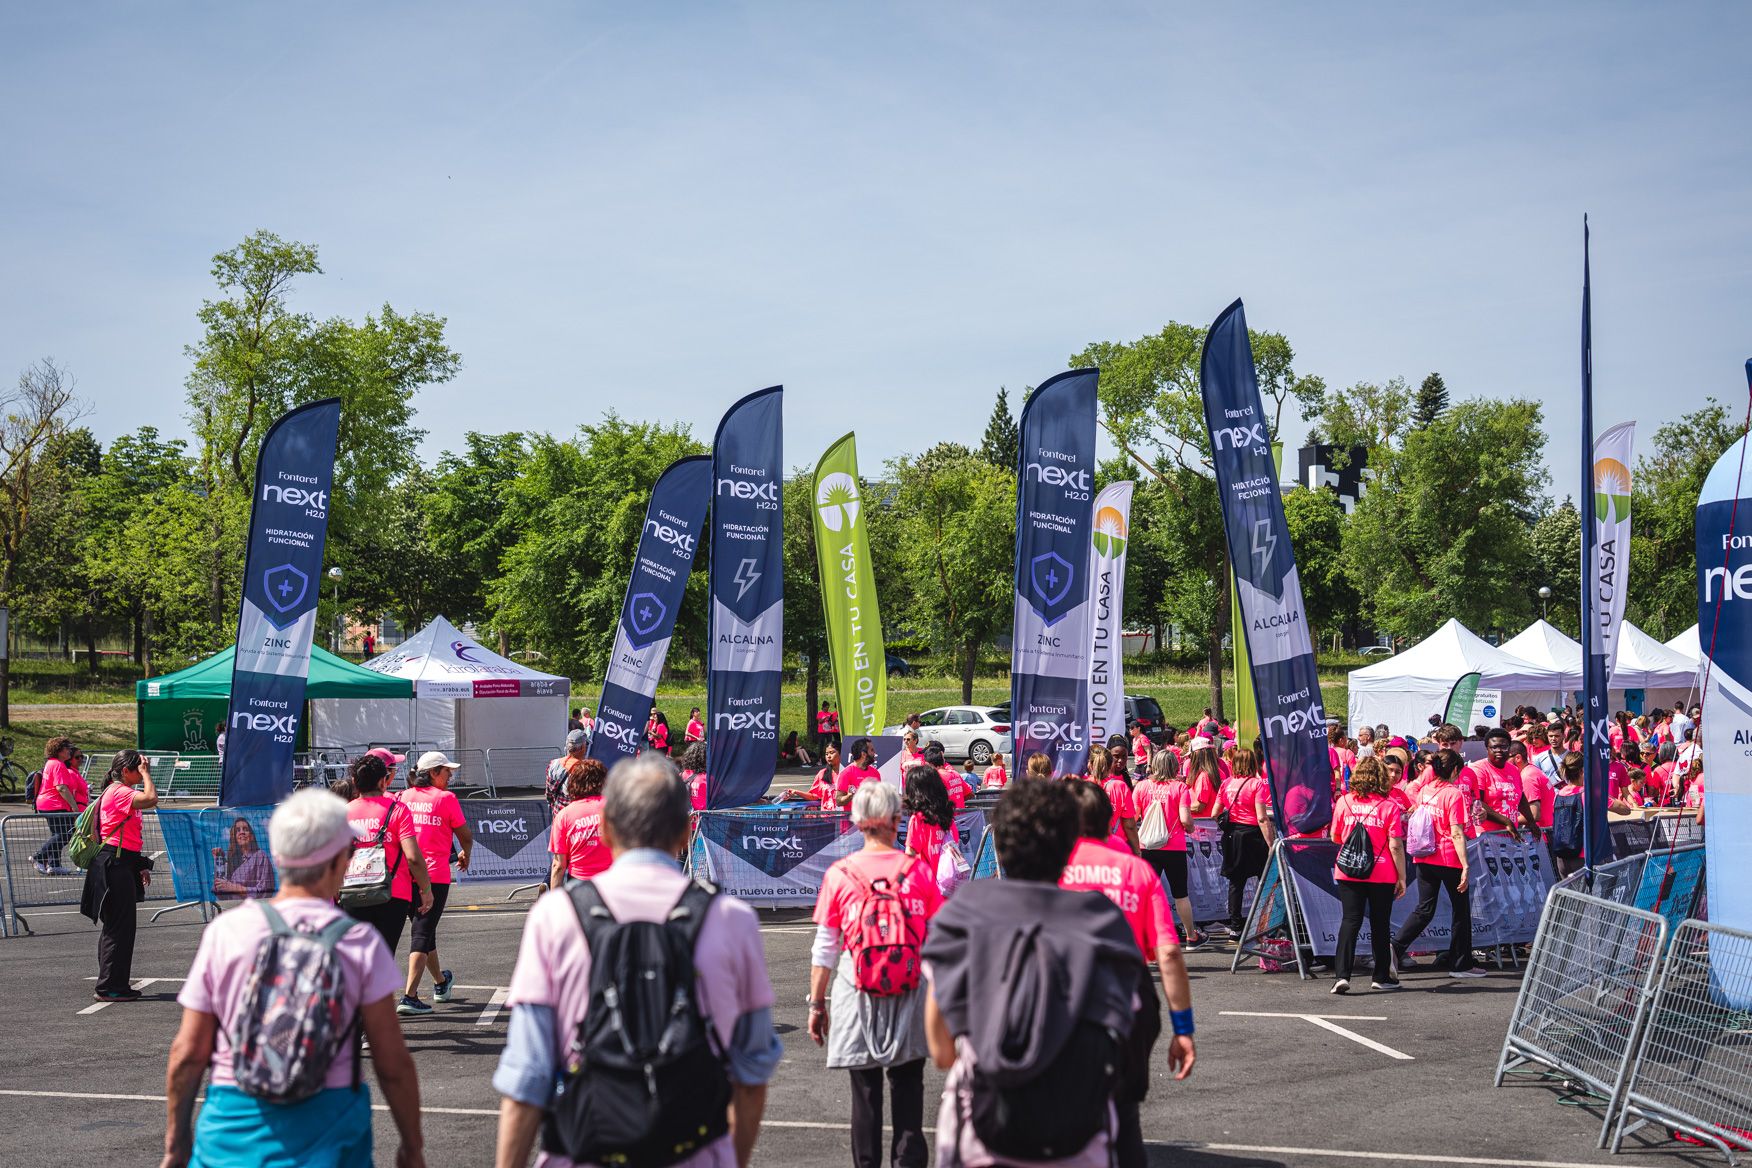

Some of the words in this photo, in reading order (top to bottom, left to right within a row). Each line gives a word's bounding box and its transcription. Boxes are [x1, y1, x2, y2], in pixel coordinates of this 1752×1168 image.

[1212, 422, 1266, 450] nex
[1038, 448, 1076, 463] Fontarel
[278, 471, 318, 484] Fontarel
[730, 464, 765, 476] Fontarel
[1026, 462, 1090, 490] next
[717, 478, 778, 500] next
[1064, 490, 1089, 500] H2.0
[262, 484, 326, 510] next
[305, 508, 325, 519] H2.0
[756, 502, 778, 510] H2.0
[658, 509, 688, 528] Fontarel
[1030, 510, 1076, 525] HIDRATACIÓN
[265, 528, 314, 540] HIDRATACIÓN
[723, 523, 769, 532] HIDRATACIÓN
[1033, 520, 1072, 534] FUNCIONAL
[268, 536, 310, 548] FUNCIONAL
[645, 518, 695, 552] next
[726, 532, 766, 540] FUNCIONAL
[672, 548, 691, 560] H2.0
[640, 556, 676, 577] HIDRATACIÓN
[641, 565, 672, 582] FUNCIONAL
[840, 542, 858, 600] CASA
[1600, 539, 1616, 604] CASA
[1098, 571, 1112, 620] CASA
[850, 606, 862, 636] TU
[264, 638, 291, 648] ZINC
[720, 634, 774, 644] ALCALINA
[1038, 634, 1060, 648] ZINC
[1094, 628, 1108, 652] TU
[622, 654, 643, 668] ZINC
[854, 641, 870, 670] EN
[1093, 660, 1108, 684] EN
[250, 698, 288, 709] Fontarel
[603, 705, 632, 722] Fontarel
[715, 709, 776, 731] next
[1092, 692, 1108, 745] UTIO
[1264, 701, 1326, 739] next
[232, 712, 298, 734] next
[274, 734, 293, 743] H2.0
[594, 716, 639, 746] next
[752, 731, 775, 740] H2.0
[1014, 720, 1082, 742] next
[1308, 727, 1328, 740] H2.0
[617, 742, 635, 754] H2.0
[1056, 743, 1082, 752] H2.0
[406, 802, 433, 813] SOMOS
[1351, 804, 1378, 816] SOMOS
[412, 814, 442, 826] RABLES
[478, 818, 528, 833] next
[575, 814, 600, 830] SOMO
[742, 835, 802, 850] next
[1063, 864, 1122, 886] SOMOS
[724, 888, 738, 896] La
[1322, 932, 1335, 942] La
